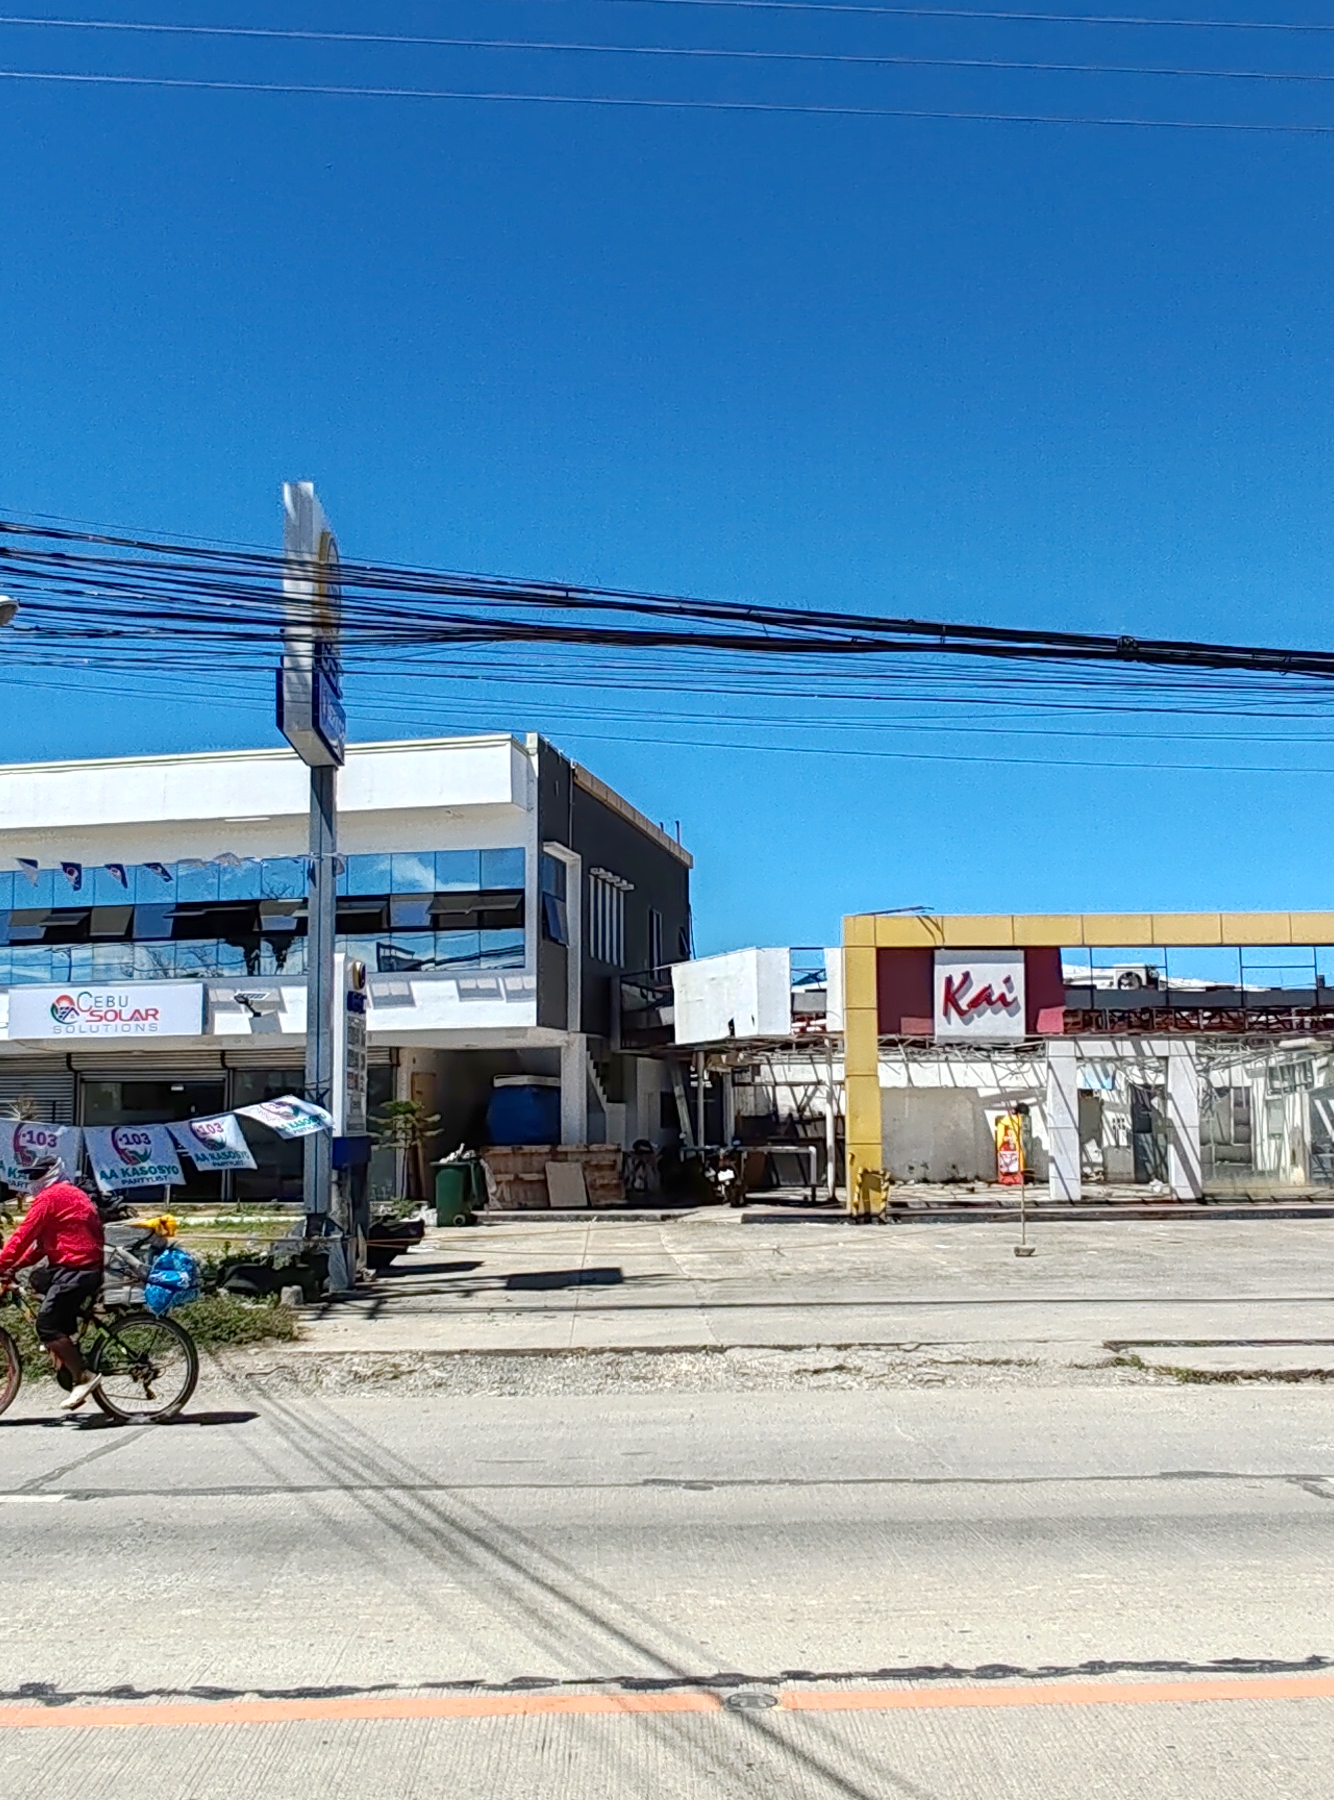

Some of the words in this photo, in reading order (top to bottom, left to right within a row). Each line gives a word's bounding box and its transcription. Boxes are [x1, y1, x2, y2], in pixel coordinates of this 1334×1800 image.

[943, 970, 1019, 1017] Kai
[77, 991, 129, 1013] CEBU
[85, 1008, 159, 1023] SOLAR
[53, 1022, 159, 1035] SOLUTIONS
[26, 1130, 59, 1149] 103
[121, 1132, 152, 1146] 103
[100, 1167, 119, 1180] AA
[120, 1164, 180, 1178] KASOSYO
